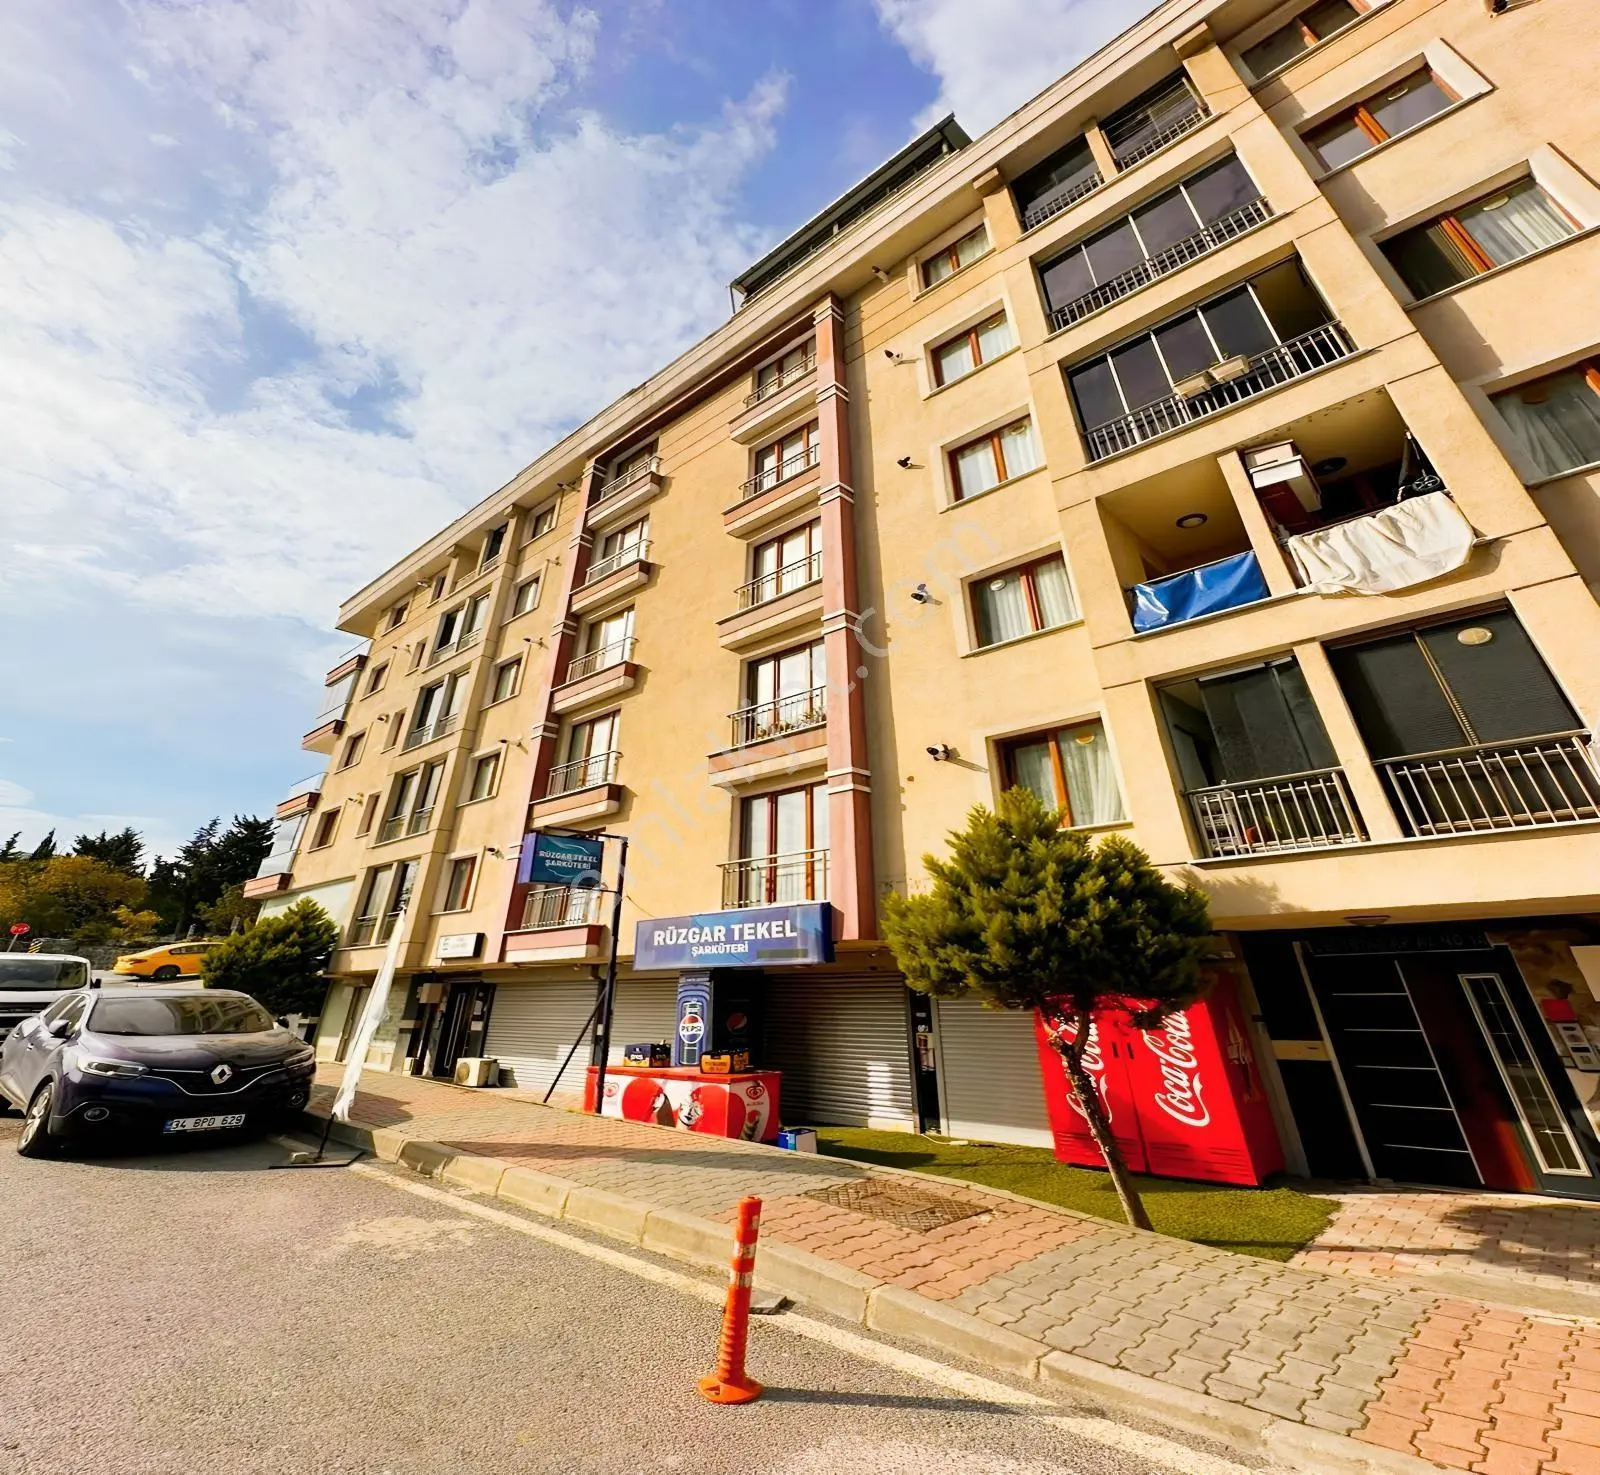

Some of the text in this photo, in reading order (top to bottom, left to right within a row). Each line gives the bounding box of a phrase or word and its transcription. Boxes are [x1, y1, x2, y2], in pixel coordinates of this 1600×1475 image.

[539, 850, 598, 863] RÜZGAR TEKEL
[653, 919, 798, 946] RÜZGAR TEKEL
[691, 942, 749, 957] ŞARKÜTERİ
[172, 1120, 187, 1129] 34
[220, 1115, 243, 1125] 629
